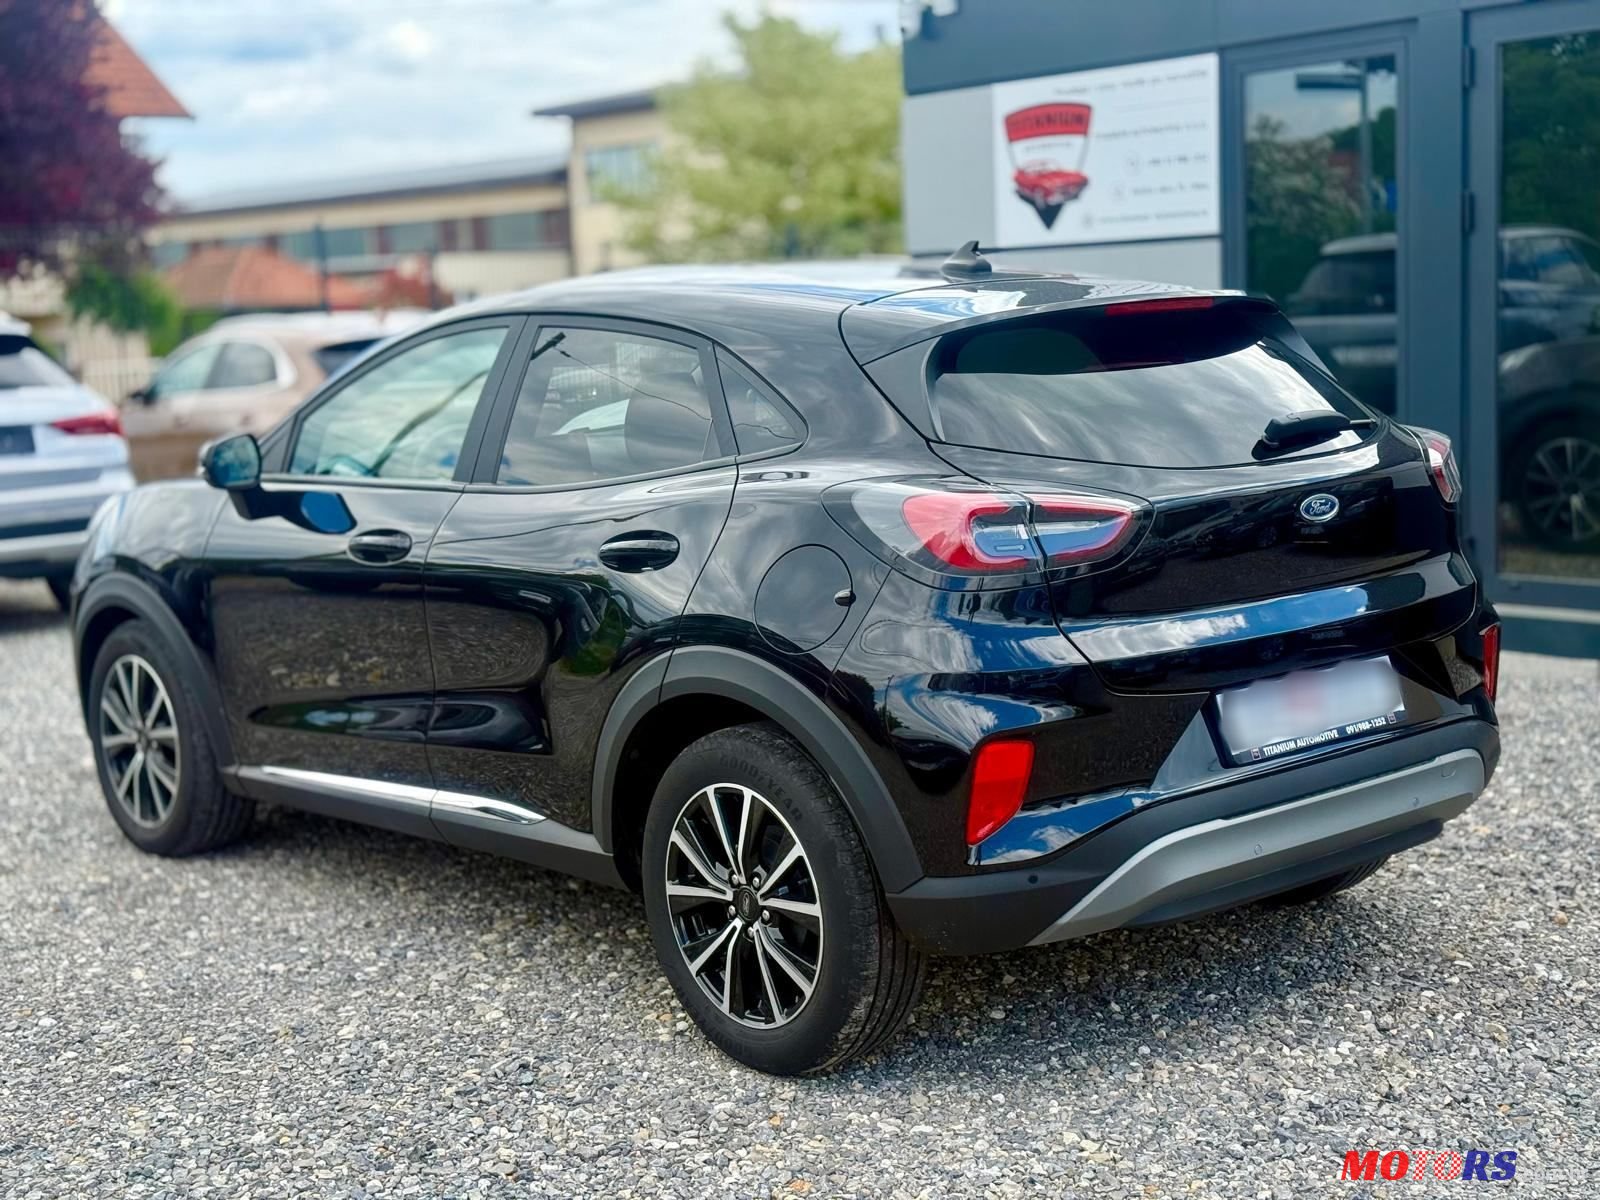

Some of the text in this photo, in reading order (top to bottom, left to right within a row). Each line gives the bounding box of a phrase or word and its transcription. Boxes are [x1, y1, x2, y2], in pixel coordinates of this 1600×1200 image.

[1309, 499, 1332, 515] Ford
[1263, 740, 1296, 757] TITANIUM
[1296, 729, 1339, 747] AUTOMOTIVE
[719, 754, 804, 822] GOODYEAR
